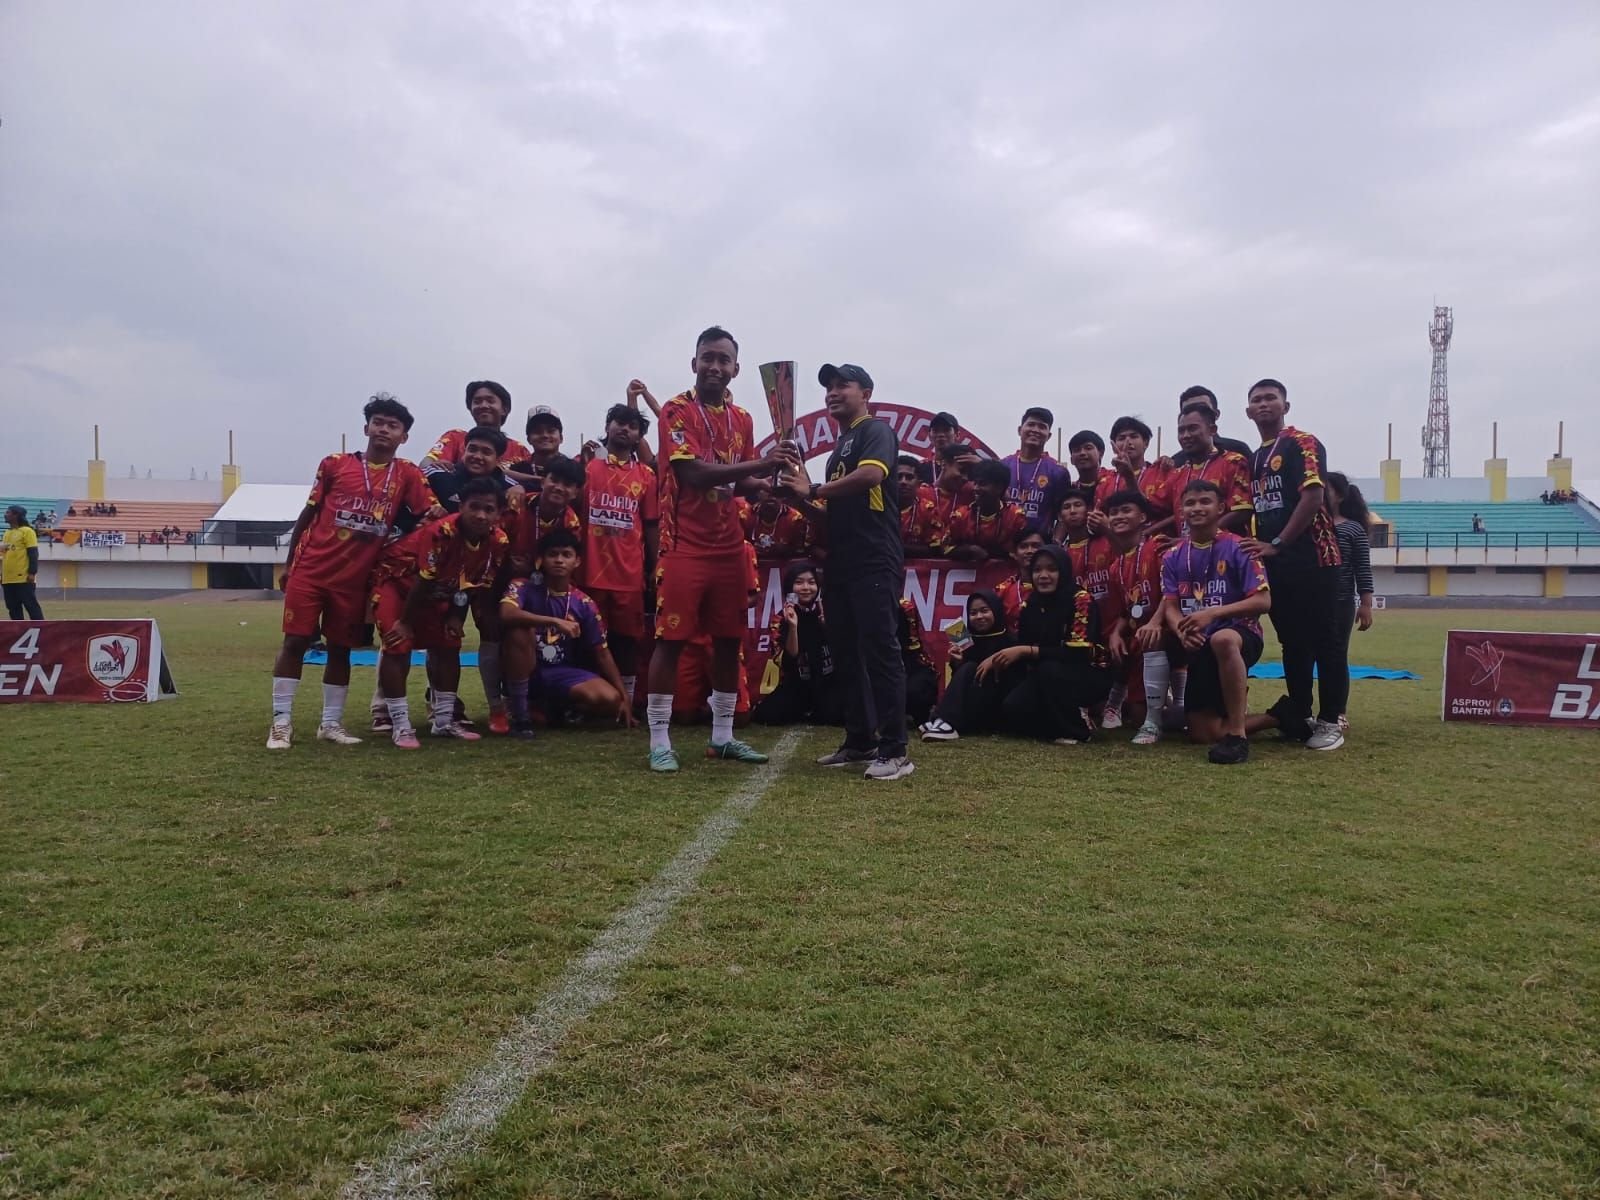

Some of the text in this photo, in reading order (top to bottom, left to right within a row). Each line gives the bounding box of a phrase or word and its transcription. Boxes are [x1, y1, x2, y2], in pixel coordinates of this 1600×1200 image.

[9, 627, 41, 660] 4
[1451, 698, 1492, 708] ASPROV
[1451, 706, 1492, 716] BANTEN
